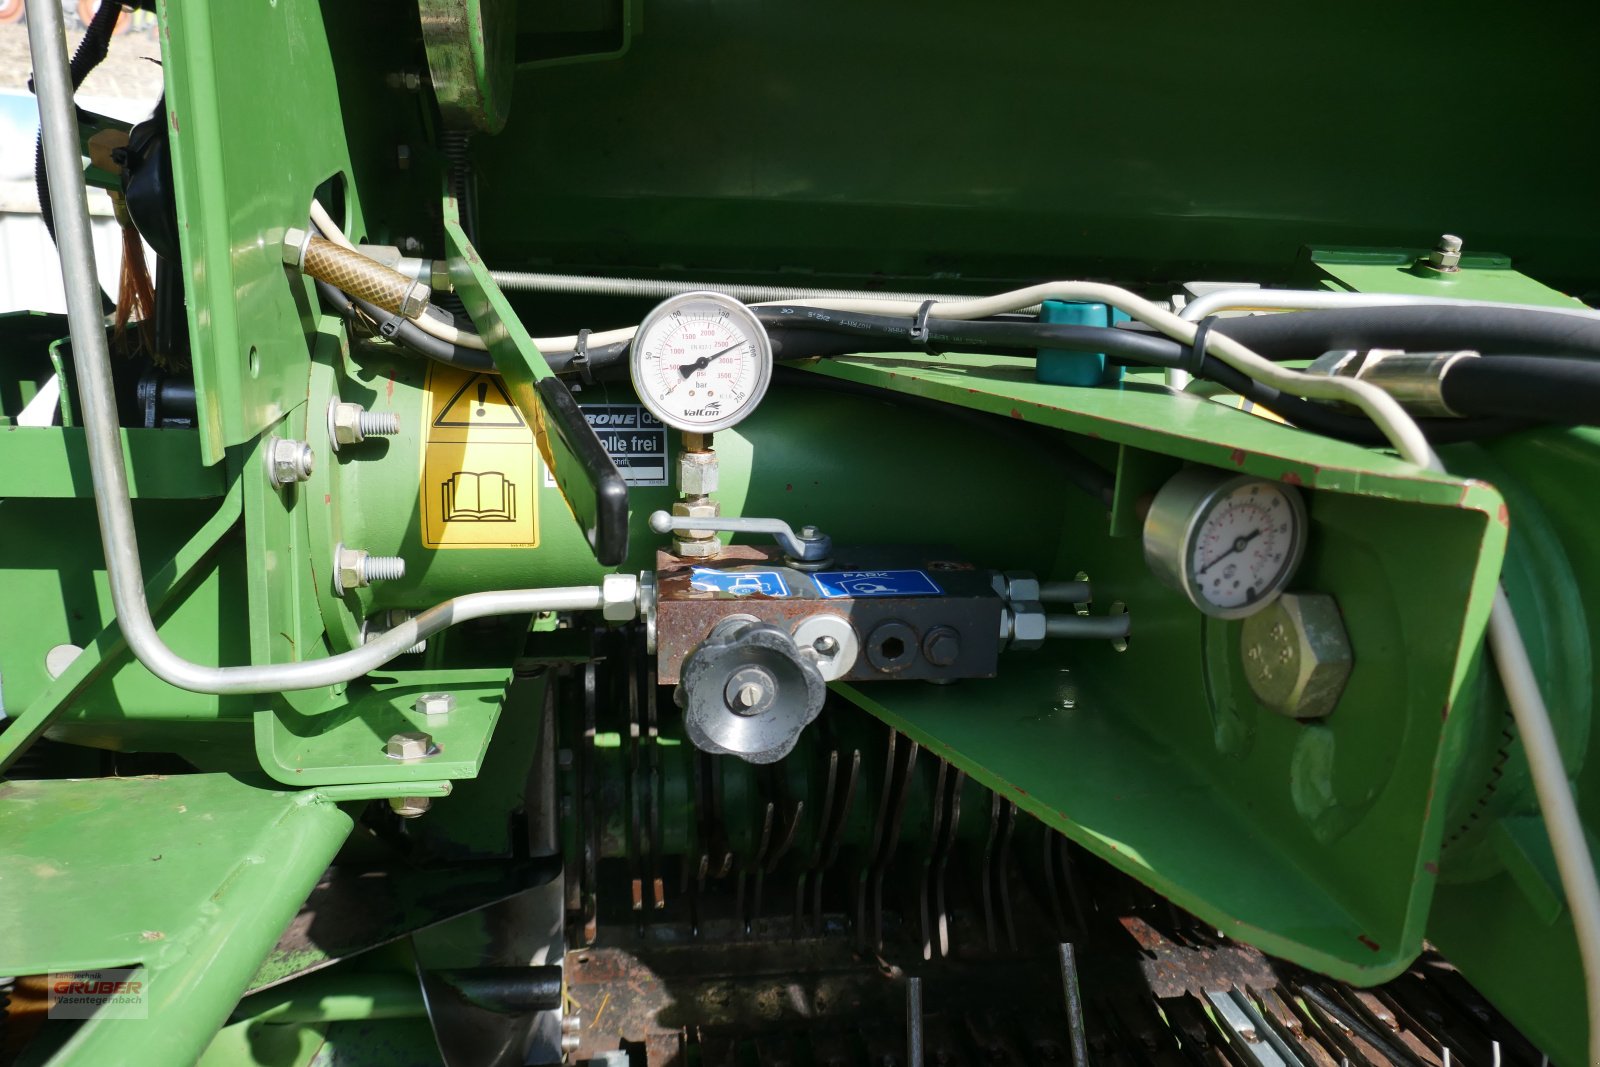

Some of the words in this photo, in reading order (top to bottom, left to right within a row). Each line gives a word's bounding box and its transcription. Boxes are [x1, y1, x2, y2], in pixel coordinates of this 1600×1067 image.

[669, 310, 681, 321] 100
[645, 351, 653, 360] 50
[748, 344, 757, 358] 200
[696, 370, 707, 378] psi
[695, 381, 707, 389] bar
[733, 391, 746, 404] 250
[584, 414, 636, 424] RONE
[631, 436, 657, 451] frei
